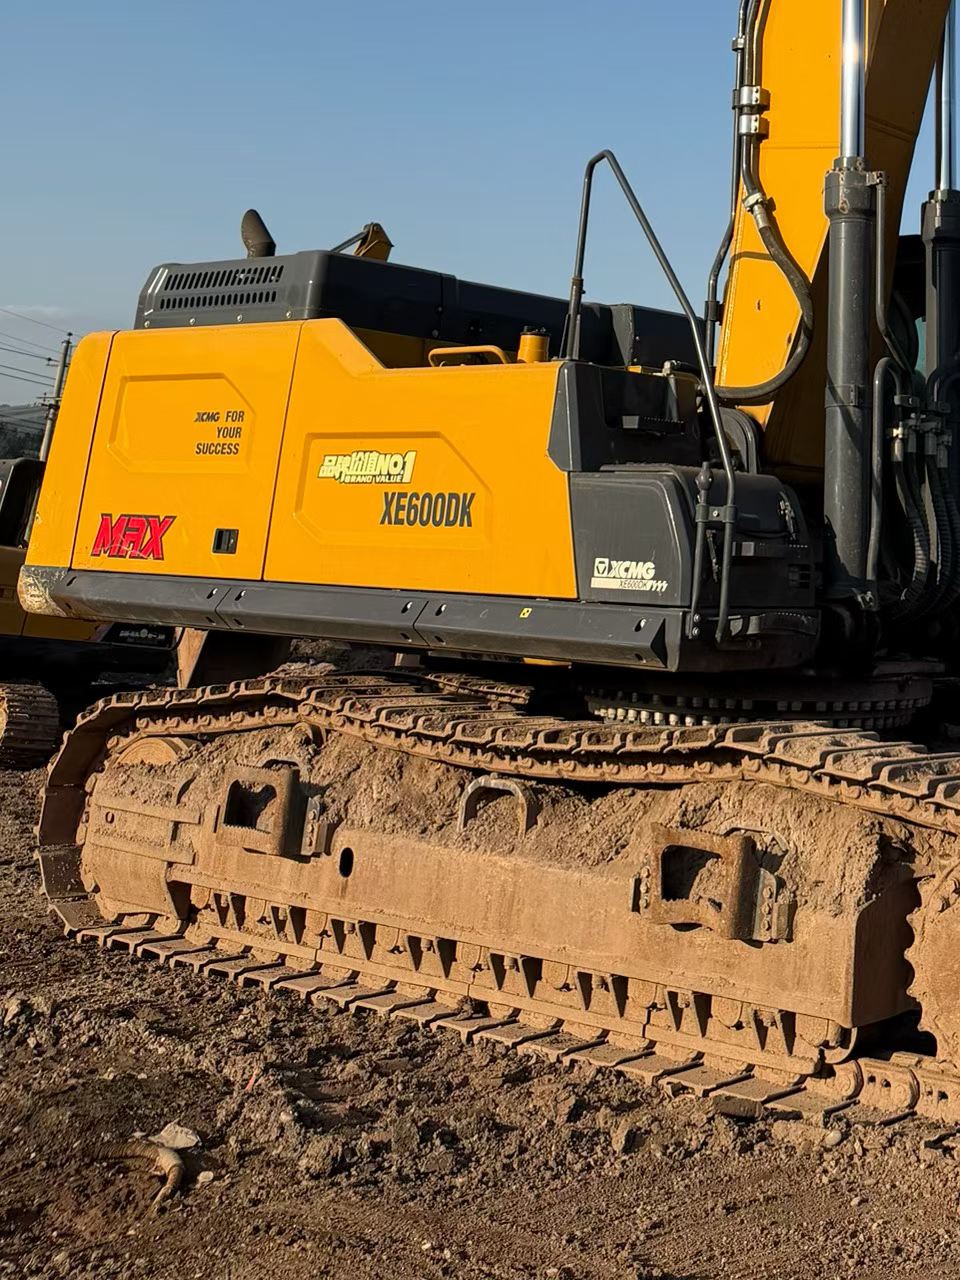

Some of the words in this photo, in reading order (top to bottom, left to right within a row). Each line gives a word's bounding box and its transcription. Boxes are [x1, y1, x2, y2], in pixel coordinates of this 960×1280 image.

[194, 411, 220, 422] XCMG
[225, 410, 245, 422] FOR
[216, 426, 242, 438] YOUR
[195, 442, 240, 455] SUCCESS
[344, 475, 373, 483] BRAND
[375, 475, 402, 483] VALUE
[380, 491, 476, 528] XE600DK
[91, 513, 177, 560] MAX
[607, 560, 656, 580] XCMG
